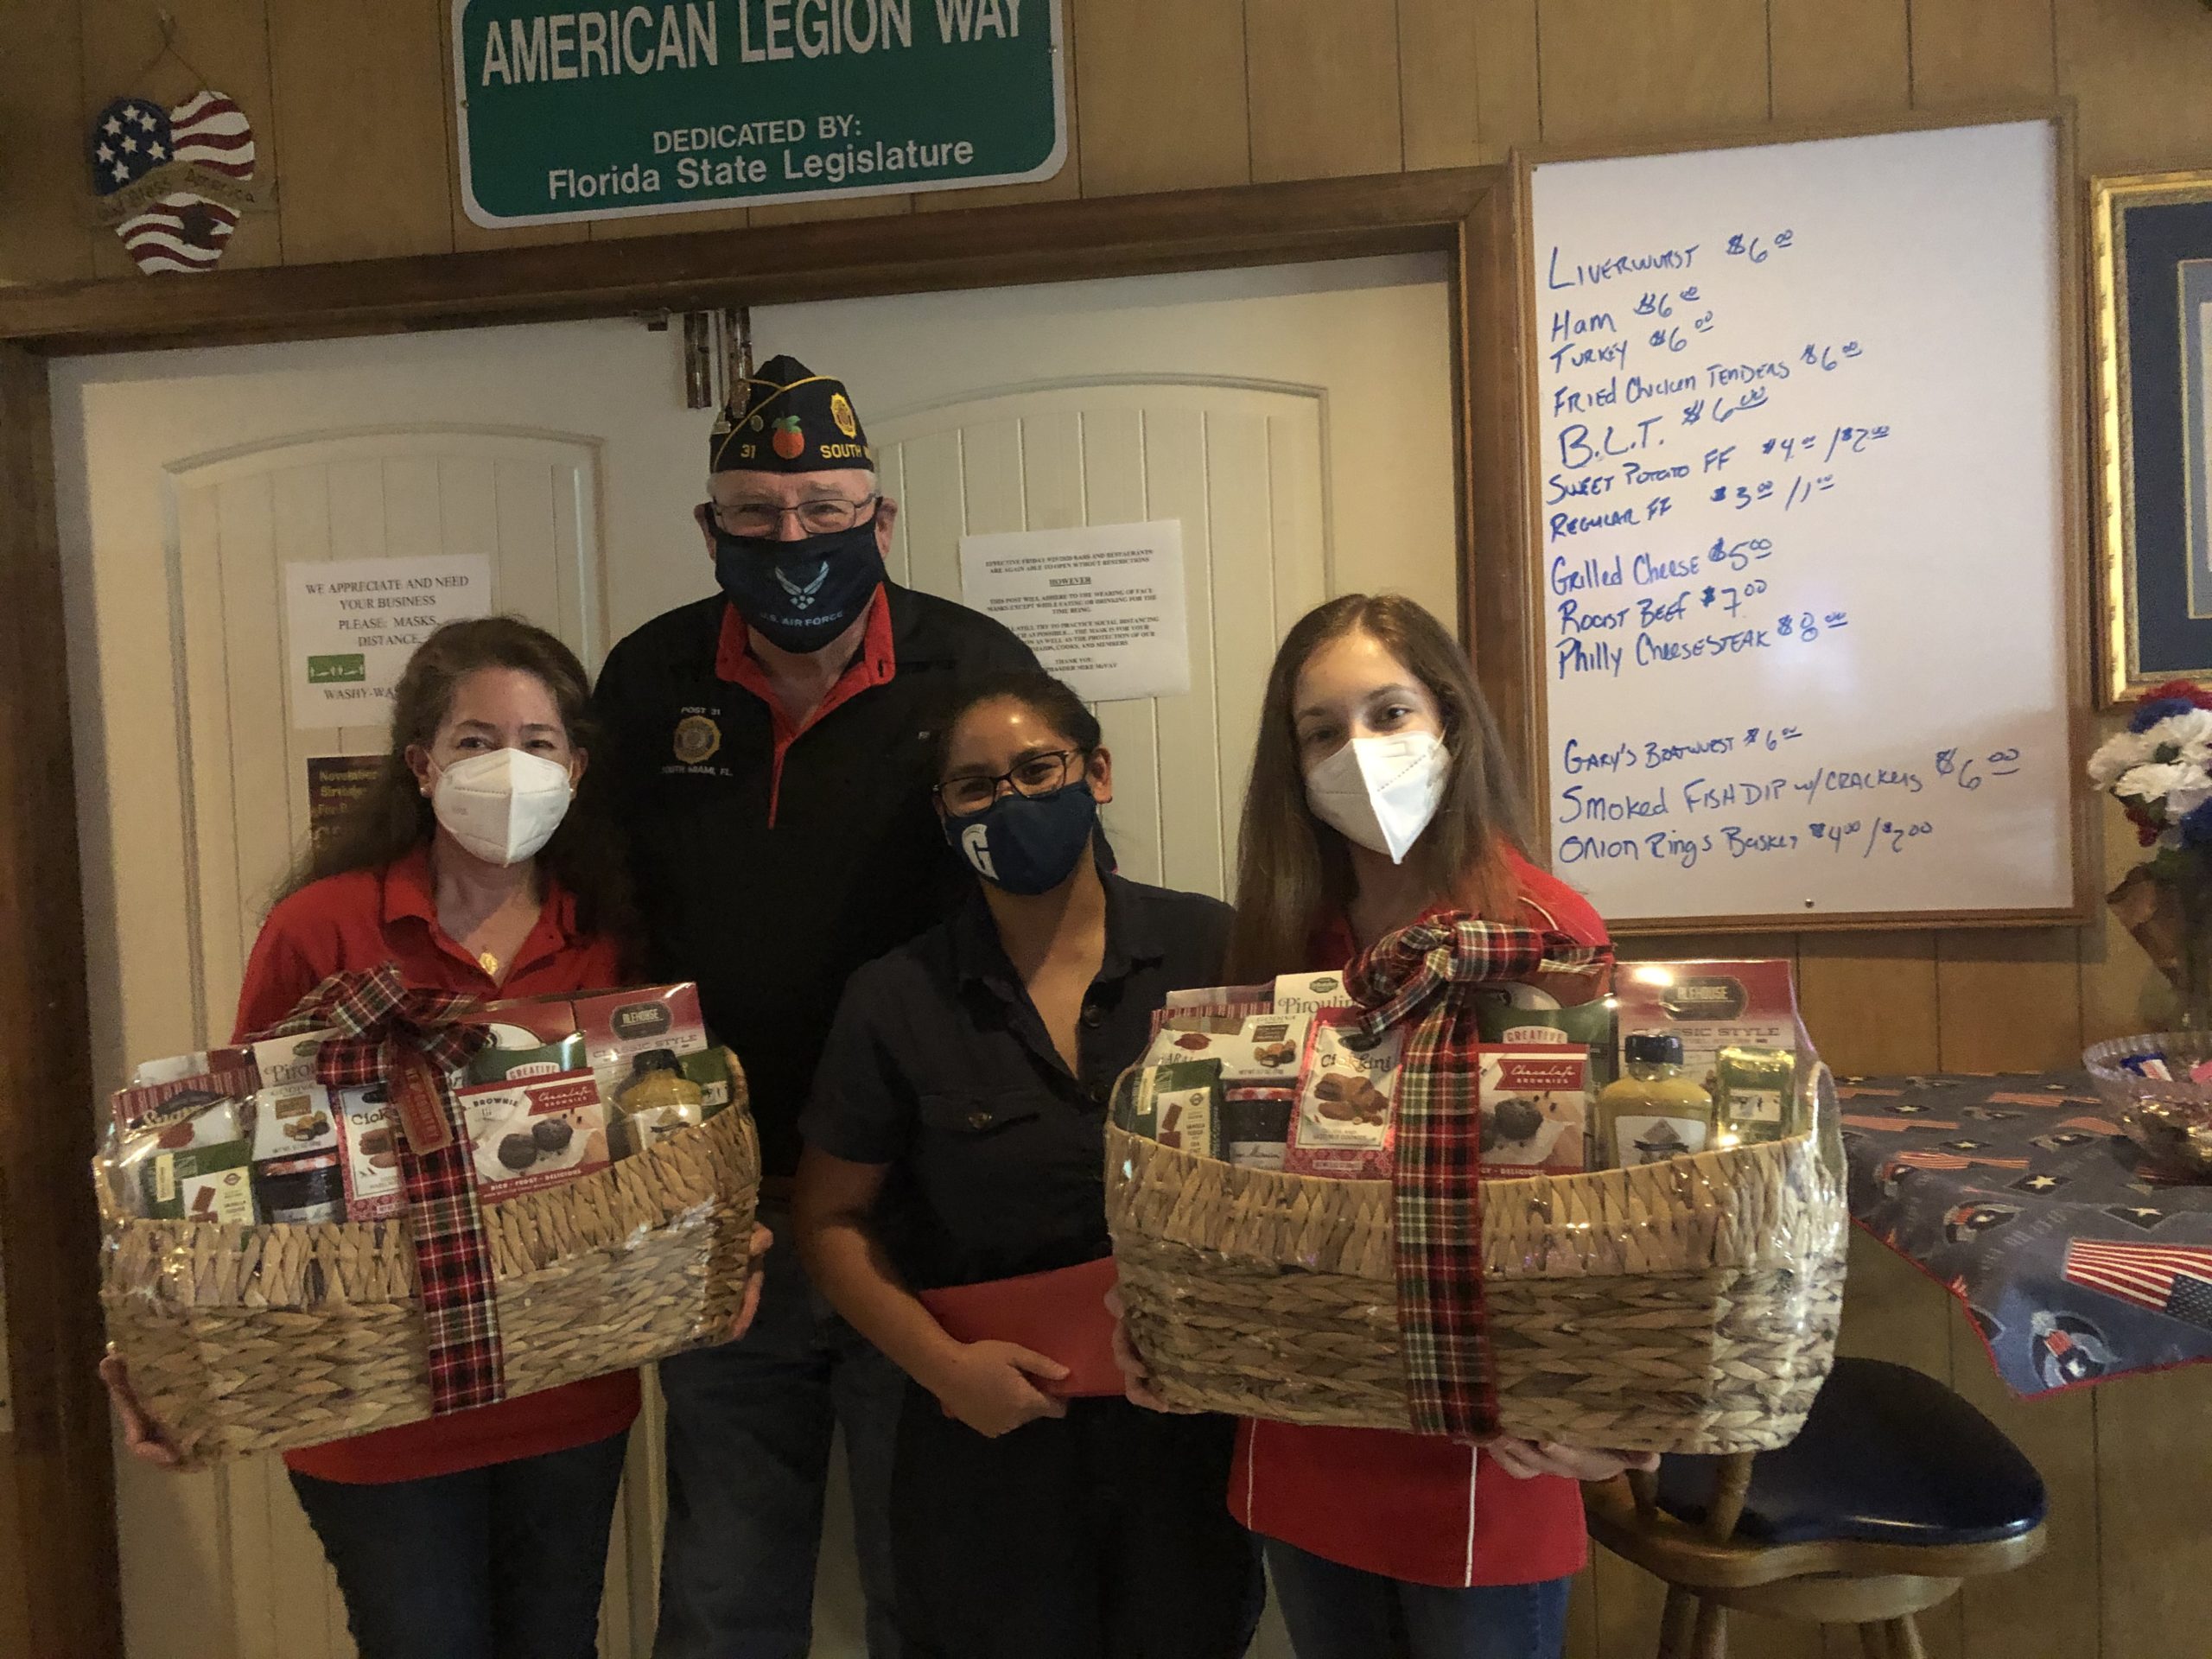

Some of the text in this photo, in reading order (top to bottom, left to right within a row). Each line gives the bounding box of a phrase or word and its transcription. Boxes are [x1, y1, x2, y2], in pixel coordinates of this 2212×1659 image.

[481, 0, 1026, 86] AMERICAN LEGION WAY
[652, 114, 862, 156] DEDICATED BY:
[549, 140, 975, 200] Florida State Legislature
[740, 444, 757, 460] 31
[820, 444, 861, 459] SOUTH
[1702, 445, 1736, 474] FF
[305, 575, 470, 596] WE APPRECIATE AND NEED
[1048, 576, 1092, 587] HOWEVER
[340, 595, 437, 611] YOUR BUSINESS
[760, 610, 845, 627] U.S. AIR FORCE
[1555, 636, 1624, 680] Philly
[711, 708, 721, 716] 31
[1738, 778, 1787, 806] DIP
[1507, 1028, 1564, 1044] CREATIVE
[1718, 1027, 1780, 1036] STYLE
[654, 1034, 698, 1048] STYLE
[508, 1064, 557, 1080] CREATIVE
